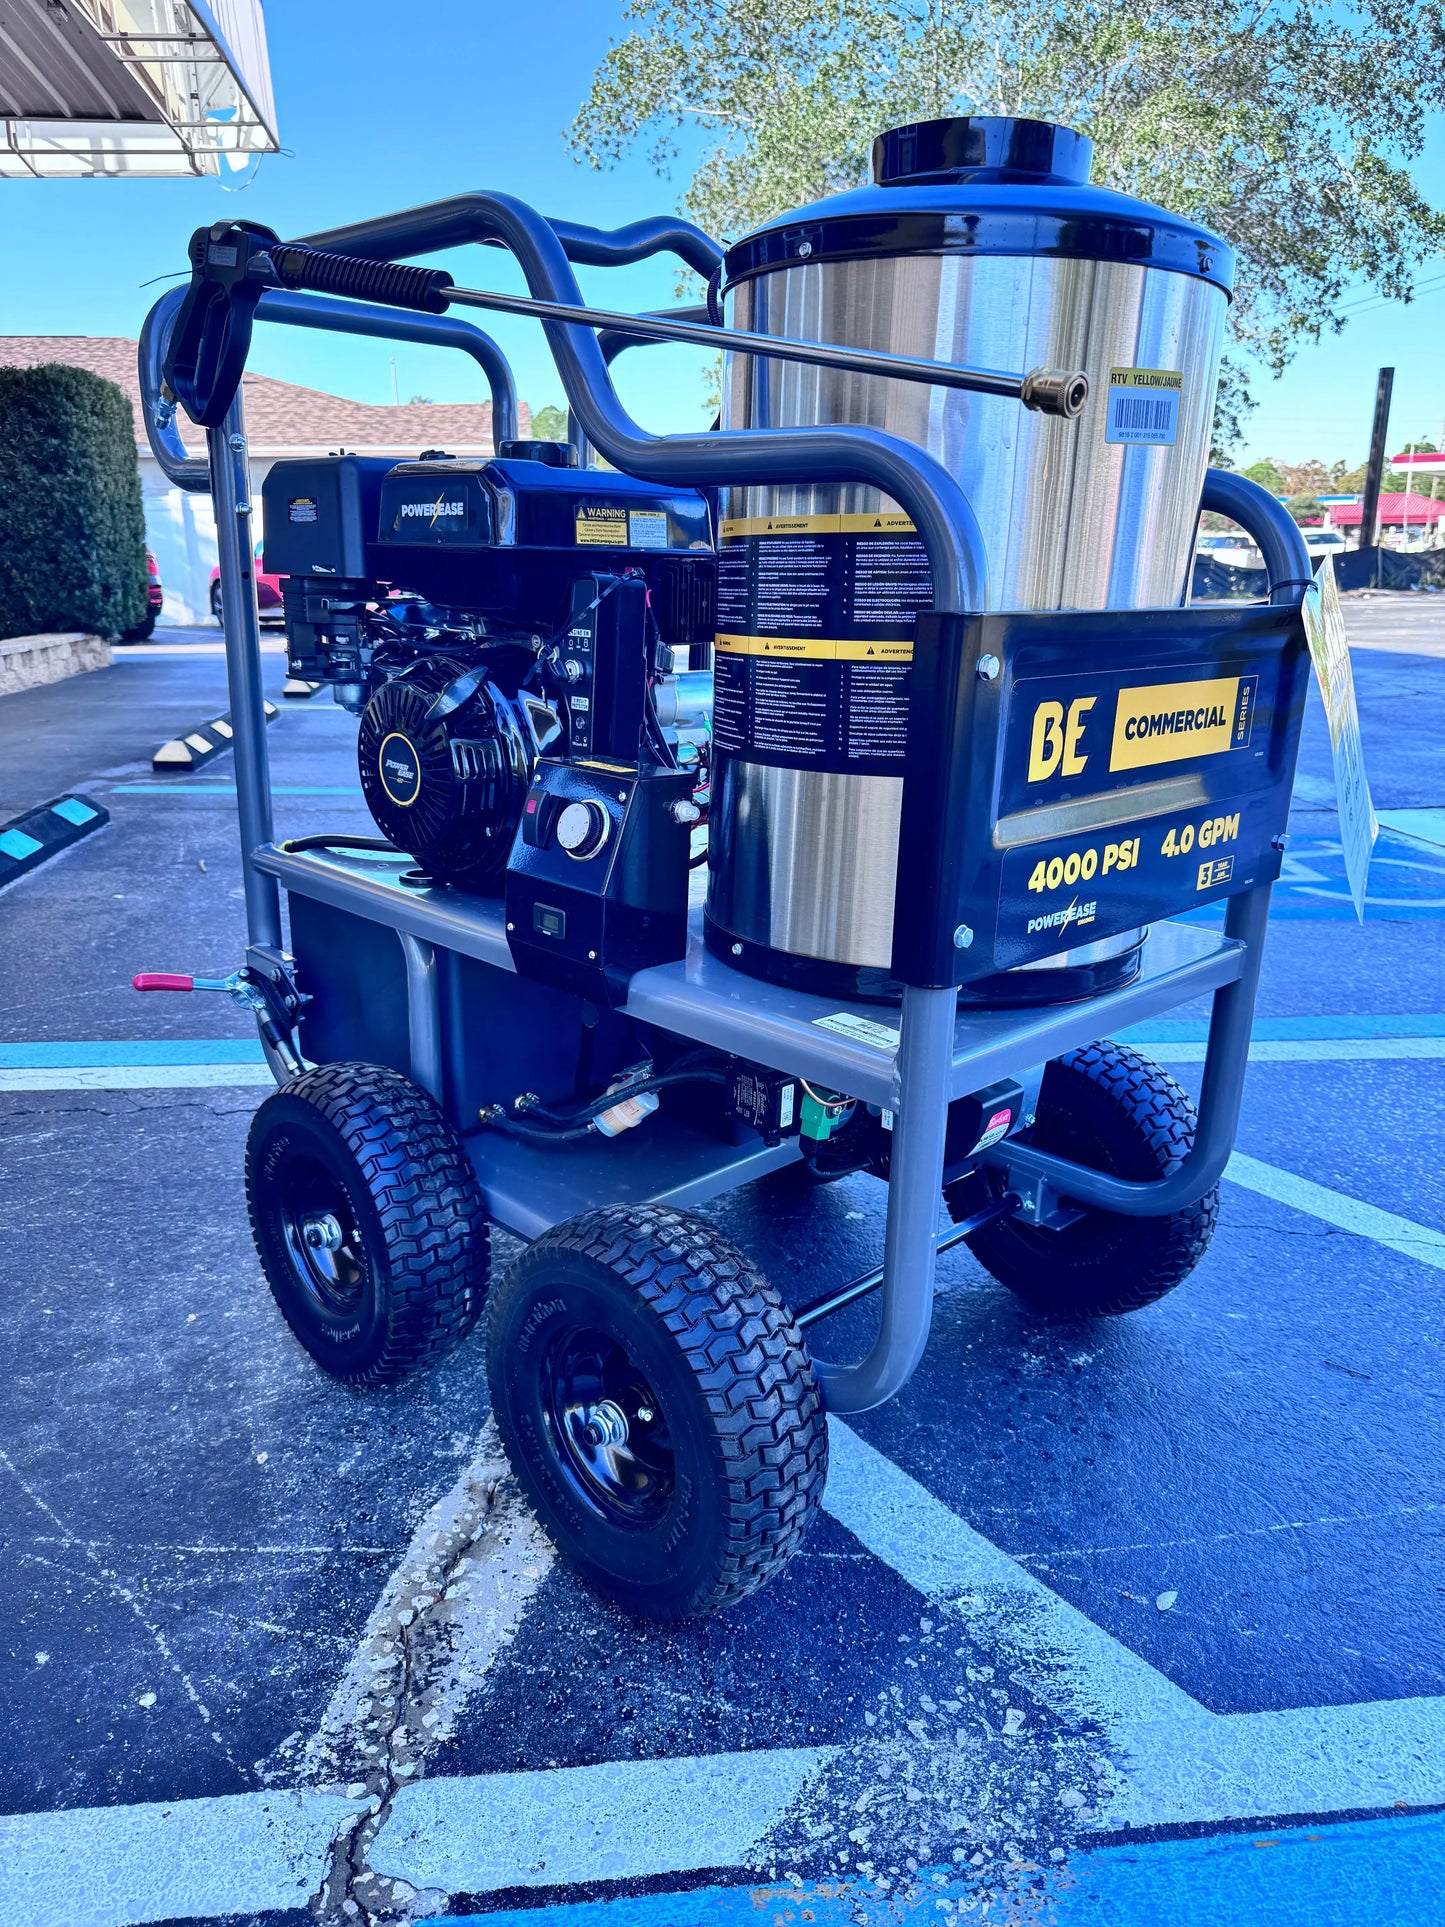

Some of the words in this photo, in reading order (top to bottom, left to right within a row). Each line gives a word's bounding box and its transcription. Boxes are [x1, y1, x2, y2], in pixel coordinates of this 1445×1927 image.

[1111, 373, 1128, 384] RTV
[1133, 374, 1182, 388] YELLOW/JAUNE
[586, 507, 626, 518] WARNING
[1124, 705, 1227, 741] COMMERCIAL
[1237, 686, 1250, 741] SERIES
[1027, 696, 1098, 783] BE
[1160, 824, 1195, 858] 4.0
[1198, 812, 1241, 849] GPM
[1027, 848, 1098, 893] 4000
[1101, 837, 1141, 876] PSI
[1200, 866, 1210, 885] 3
[1027, 901, 1097, 934] POWEREASE
